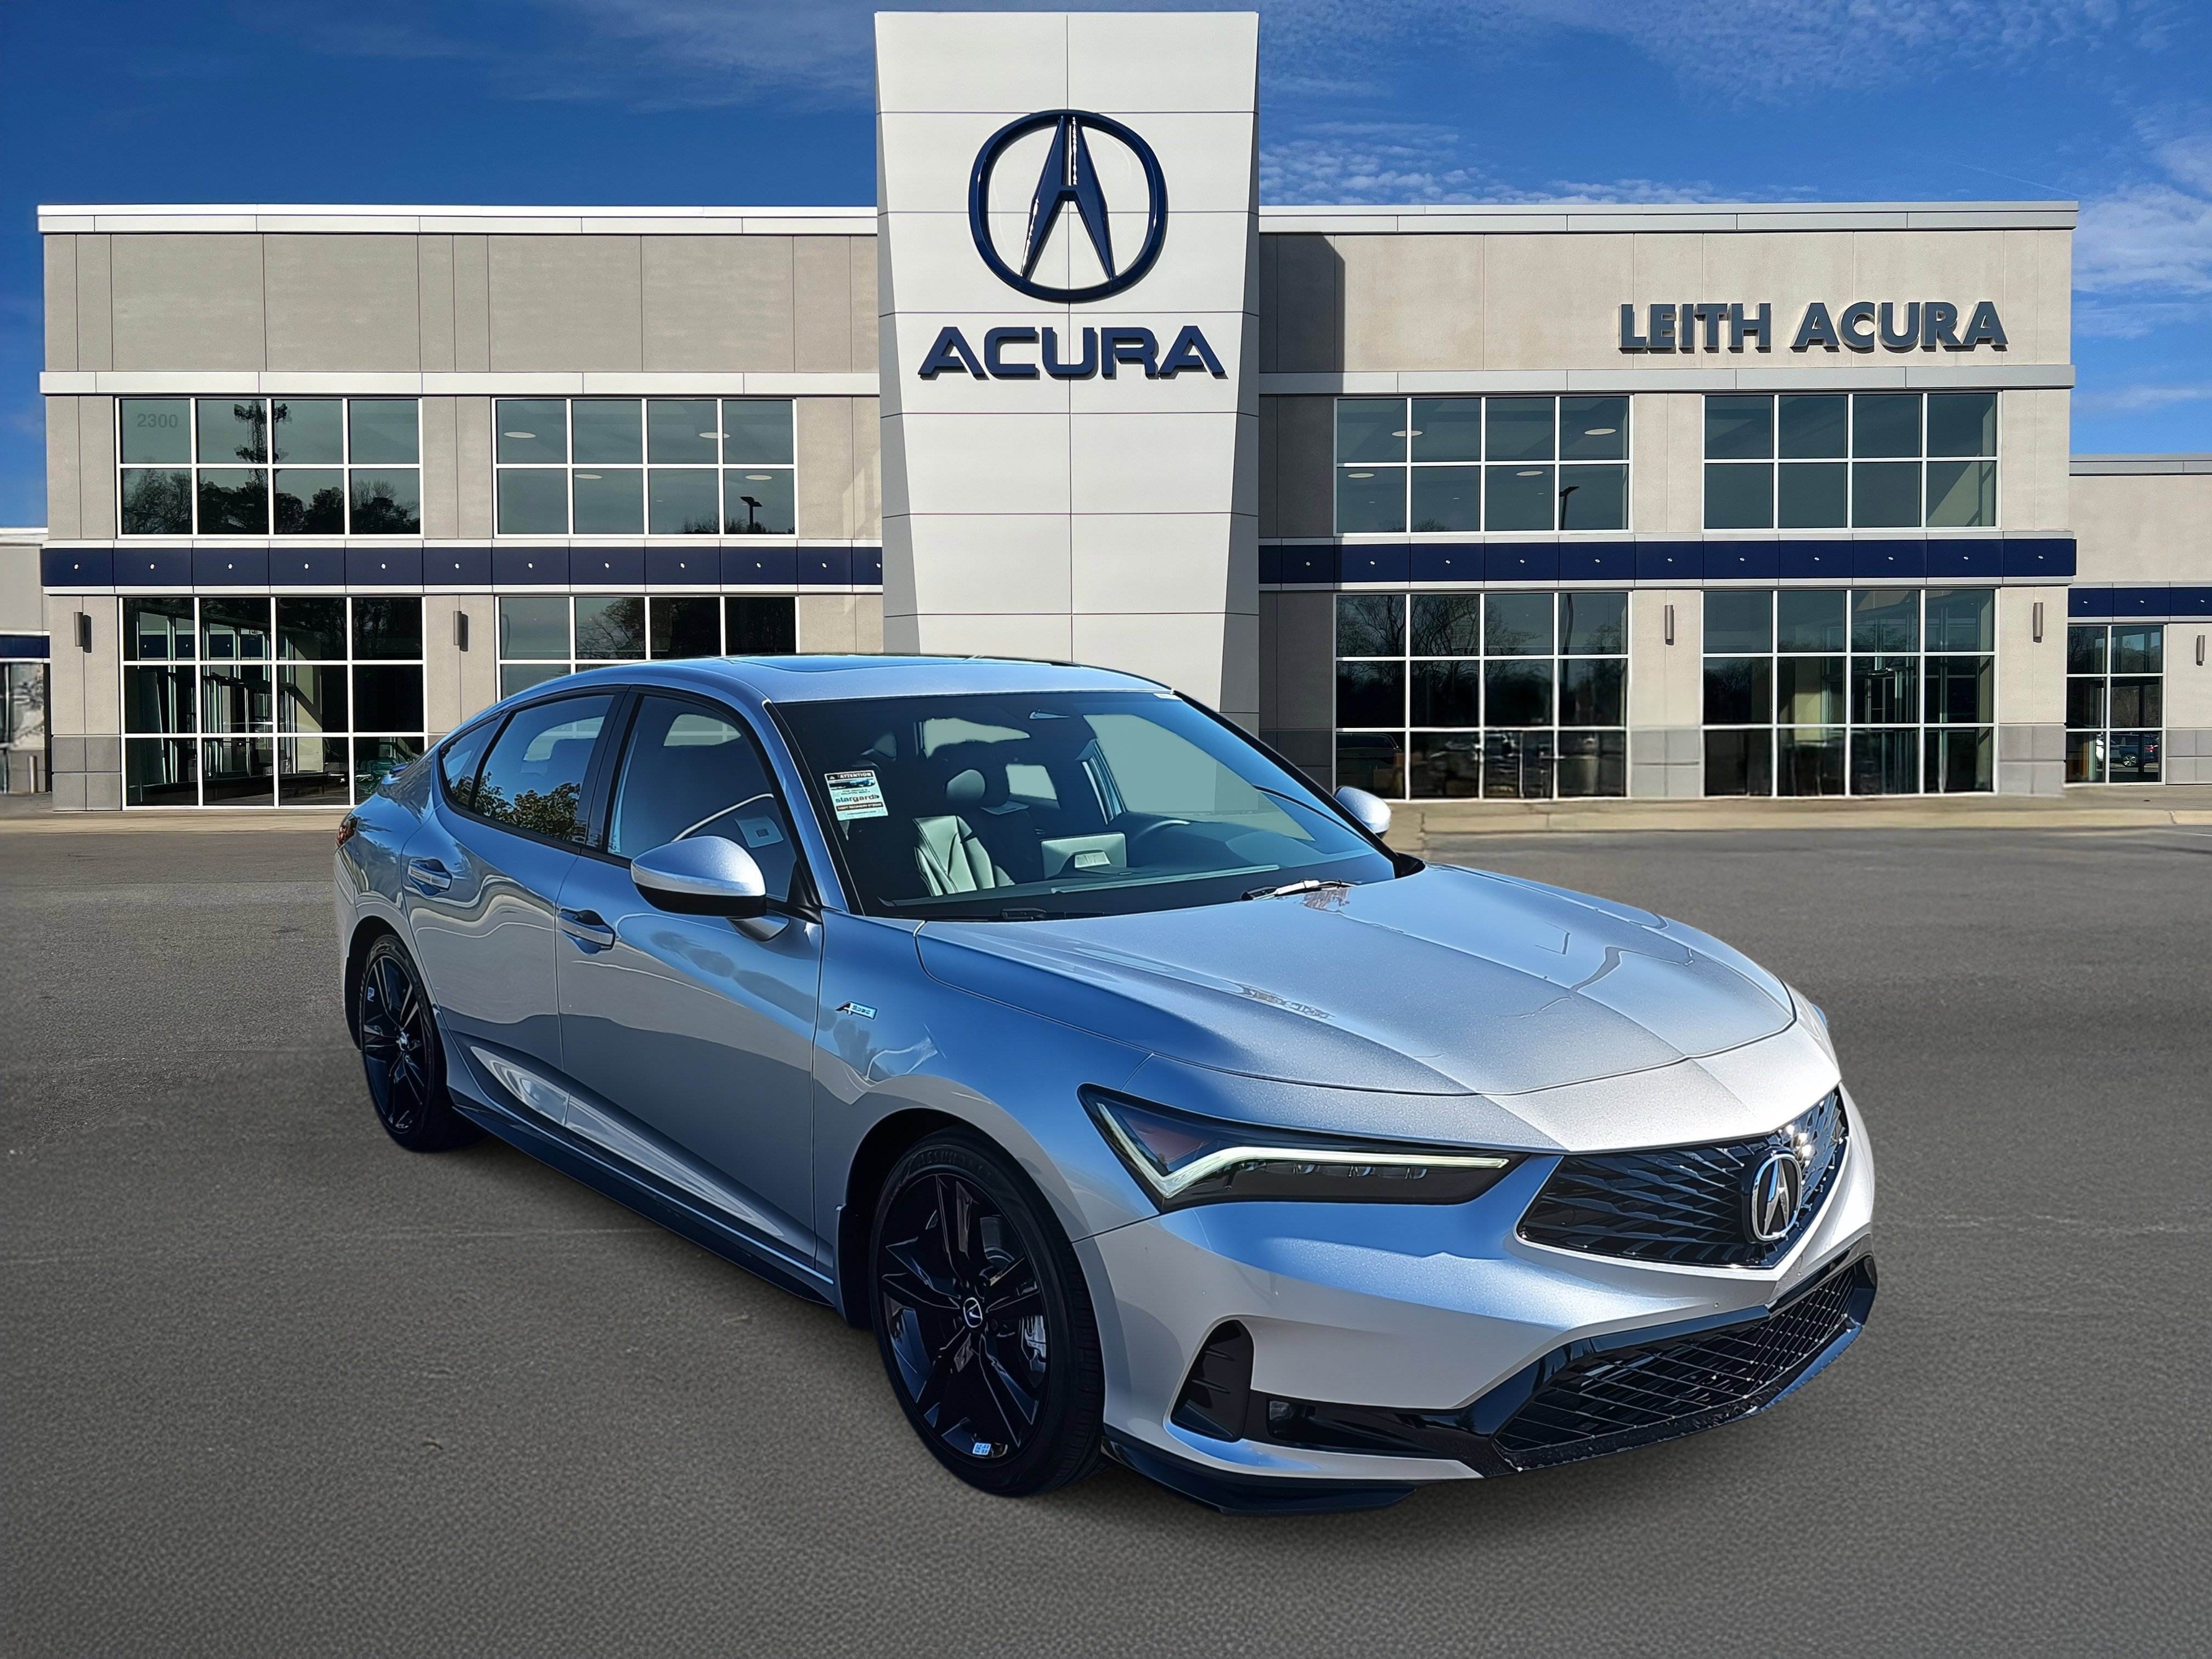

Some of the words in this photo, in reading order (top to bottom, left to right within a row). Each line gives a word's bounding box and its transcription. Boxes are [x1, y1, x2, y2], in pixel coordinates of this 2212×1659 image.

[918, 326, 1227, 379] ACURA
[1618, 303, 1771, 353] LEITH
[1789, 301, 2008, 353] ACURA
[137, 413, 178, 428] 2300
